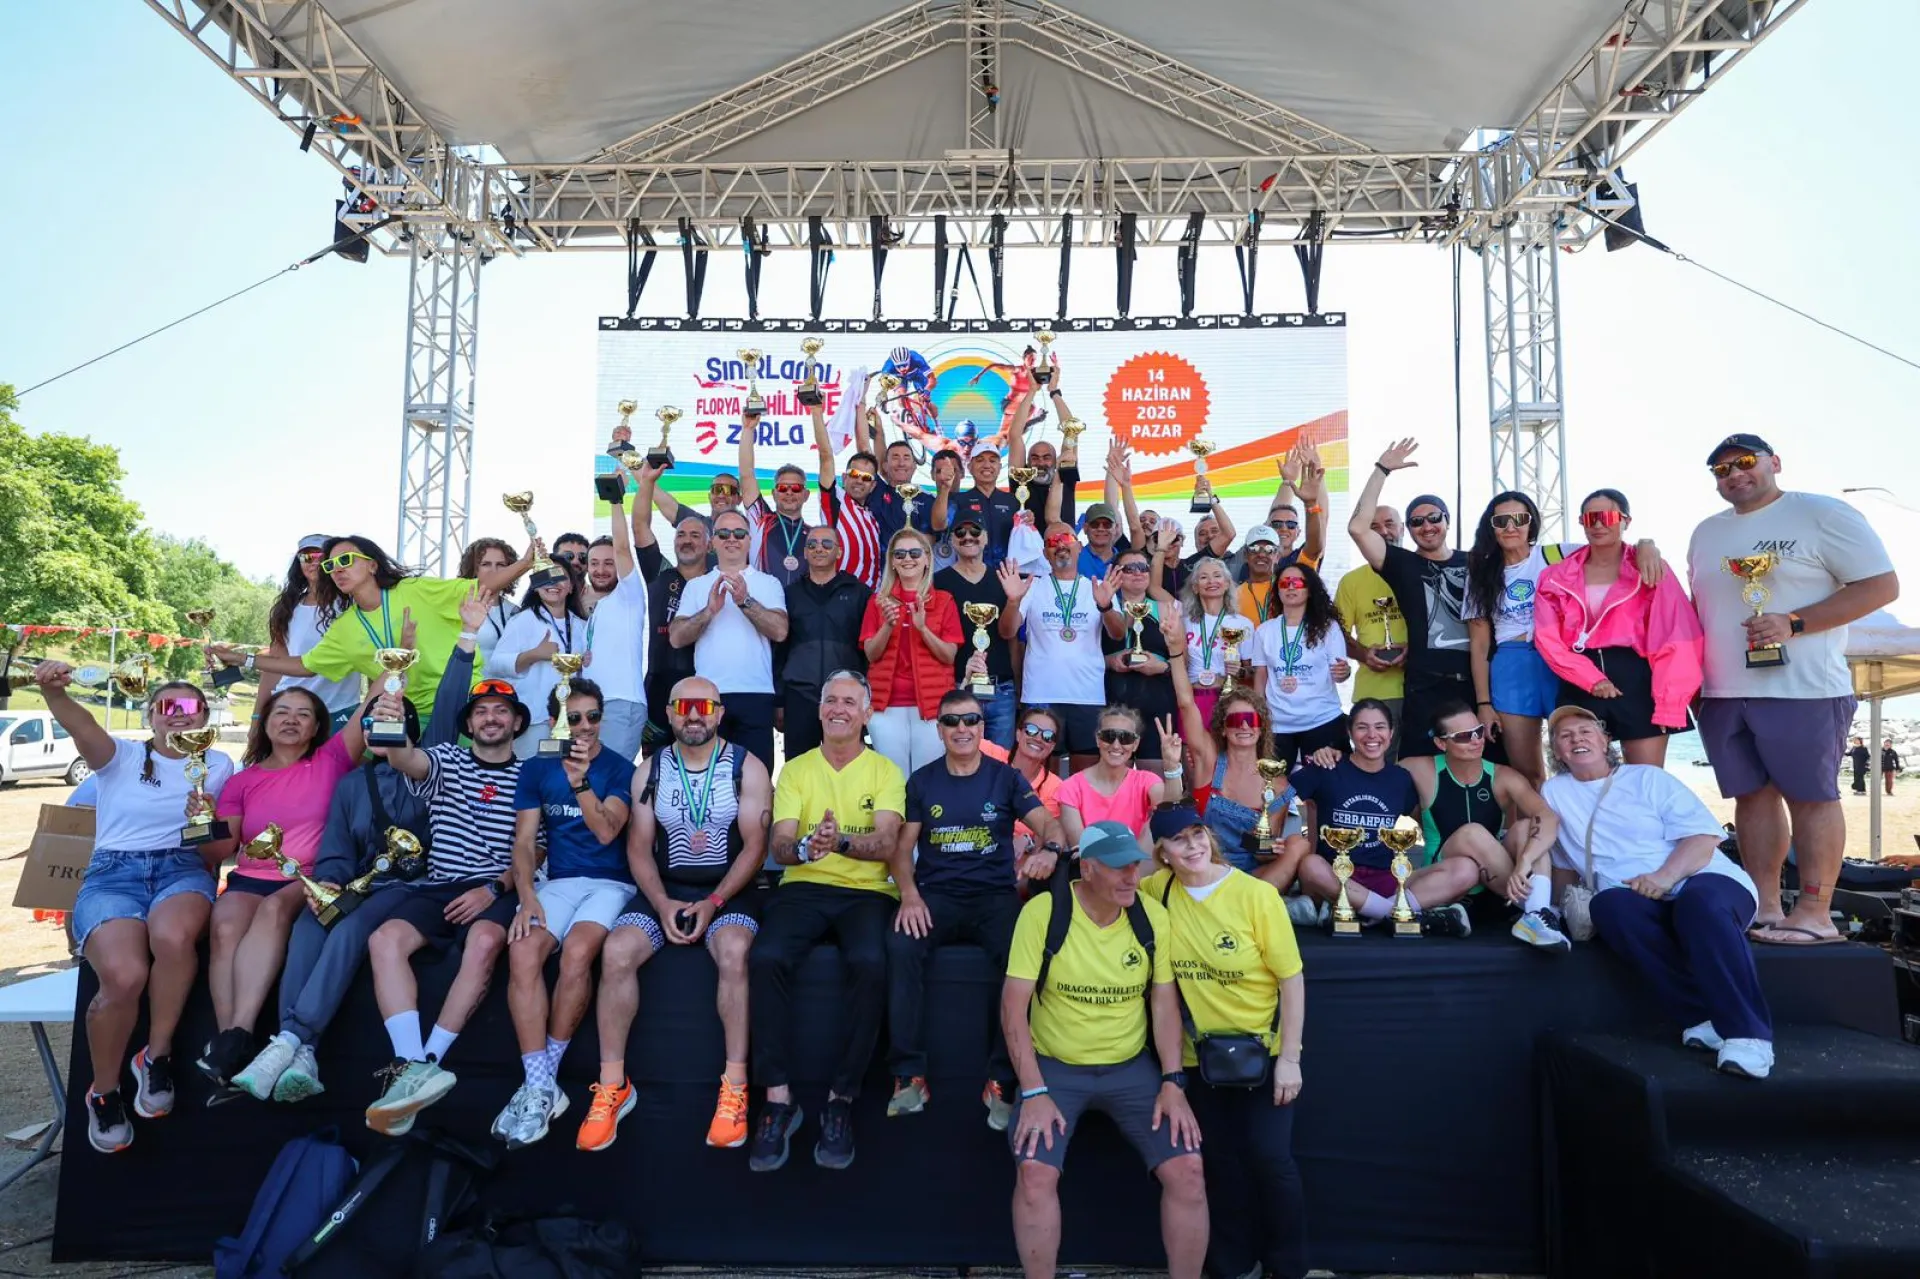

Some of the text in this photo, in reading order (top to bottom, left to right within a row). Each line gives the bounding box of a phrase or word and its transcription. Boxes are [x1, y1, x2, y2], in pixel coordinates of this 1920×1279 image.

[1147, 368, 1165, 383] 14
[1122, 383, 1191, 402] HAZİRAN
[696, 396, 741, 415] FLORYA
[1136, 405, 1177, 420] 2026
[1131, 424, 1182, 438] PAZAR
[1057, 982, 1098, 994] DRAGOS
